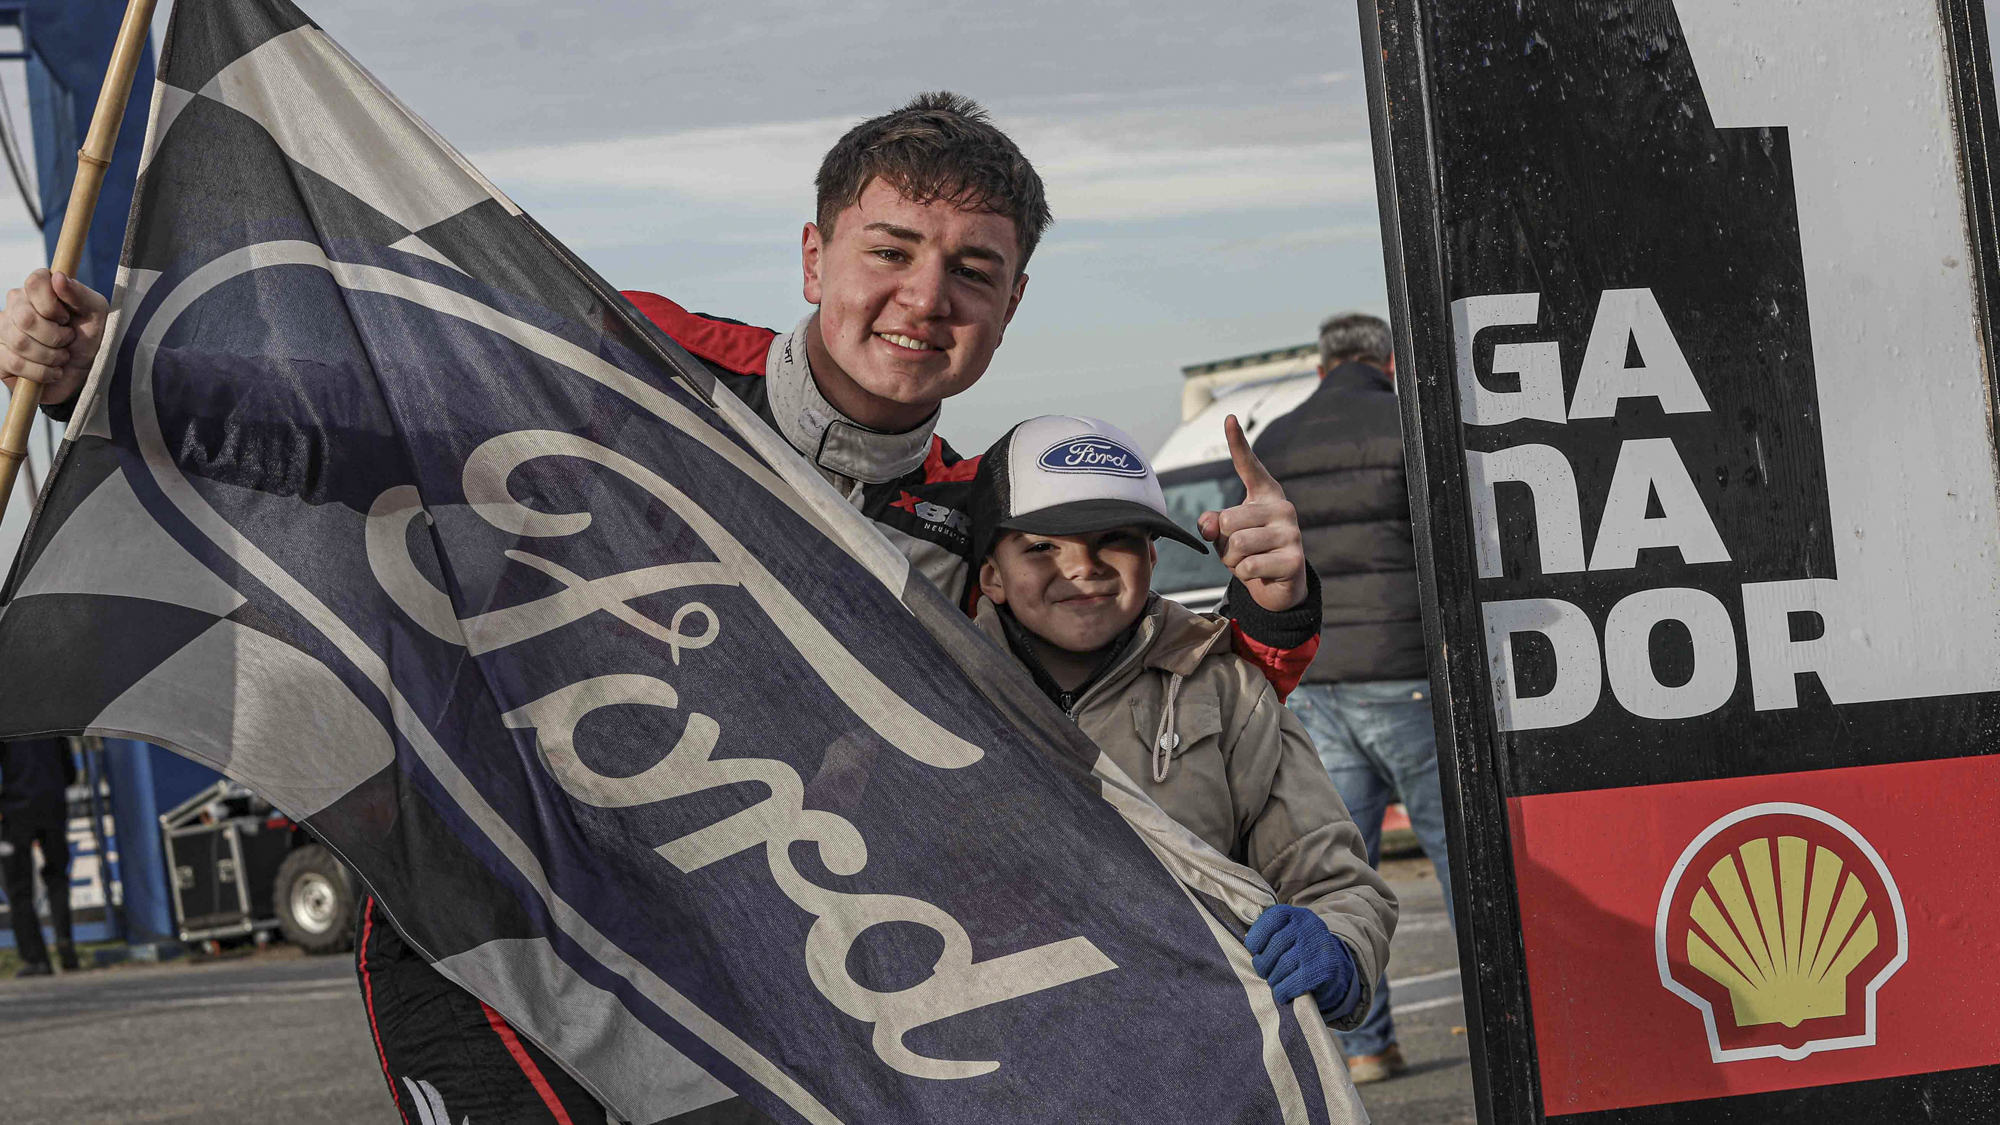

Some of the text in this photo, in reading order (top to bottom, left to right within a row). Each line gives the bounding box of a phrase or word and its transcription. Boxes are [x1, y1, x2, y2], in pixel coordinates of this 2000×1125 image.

[1450, 287, 1711, 425] GA
[1065, 442, 1130, 469] Ford
[1480, 577, 1838, 734] DOR
[365, 428, 1120, 1080] Ford
